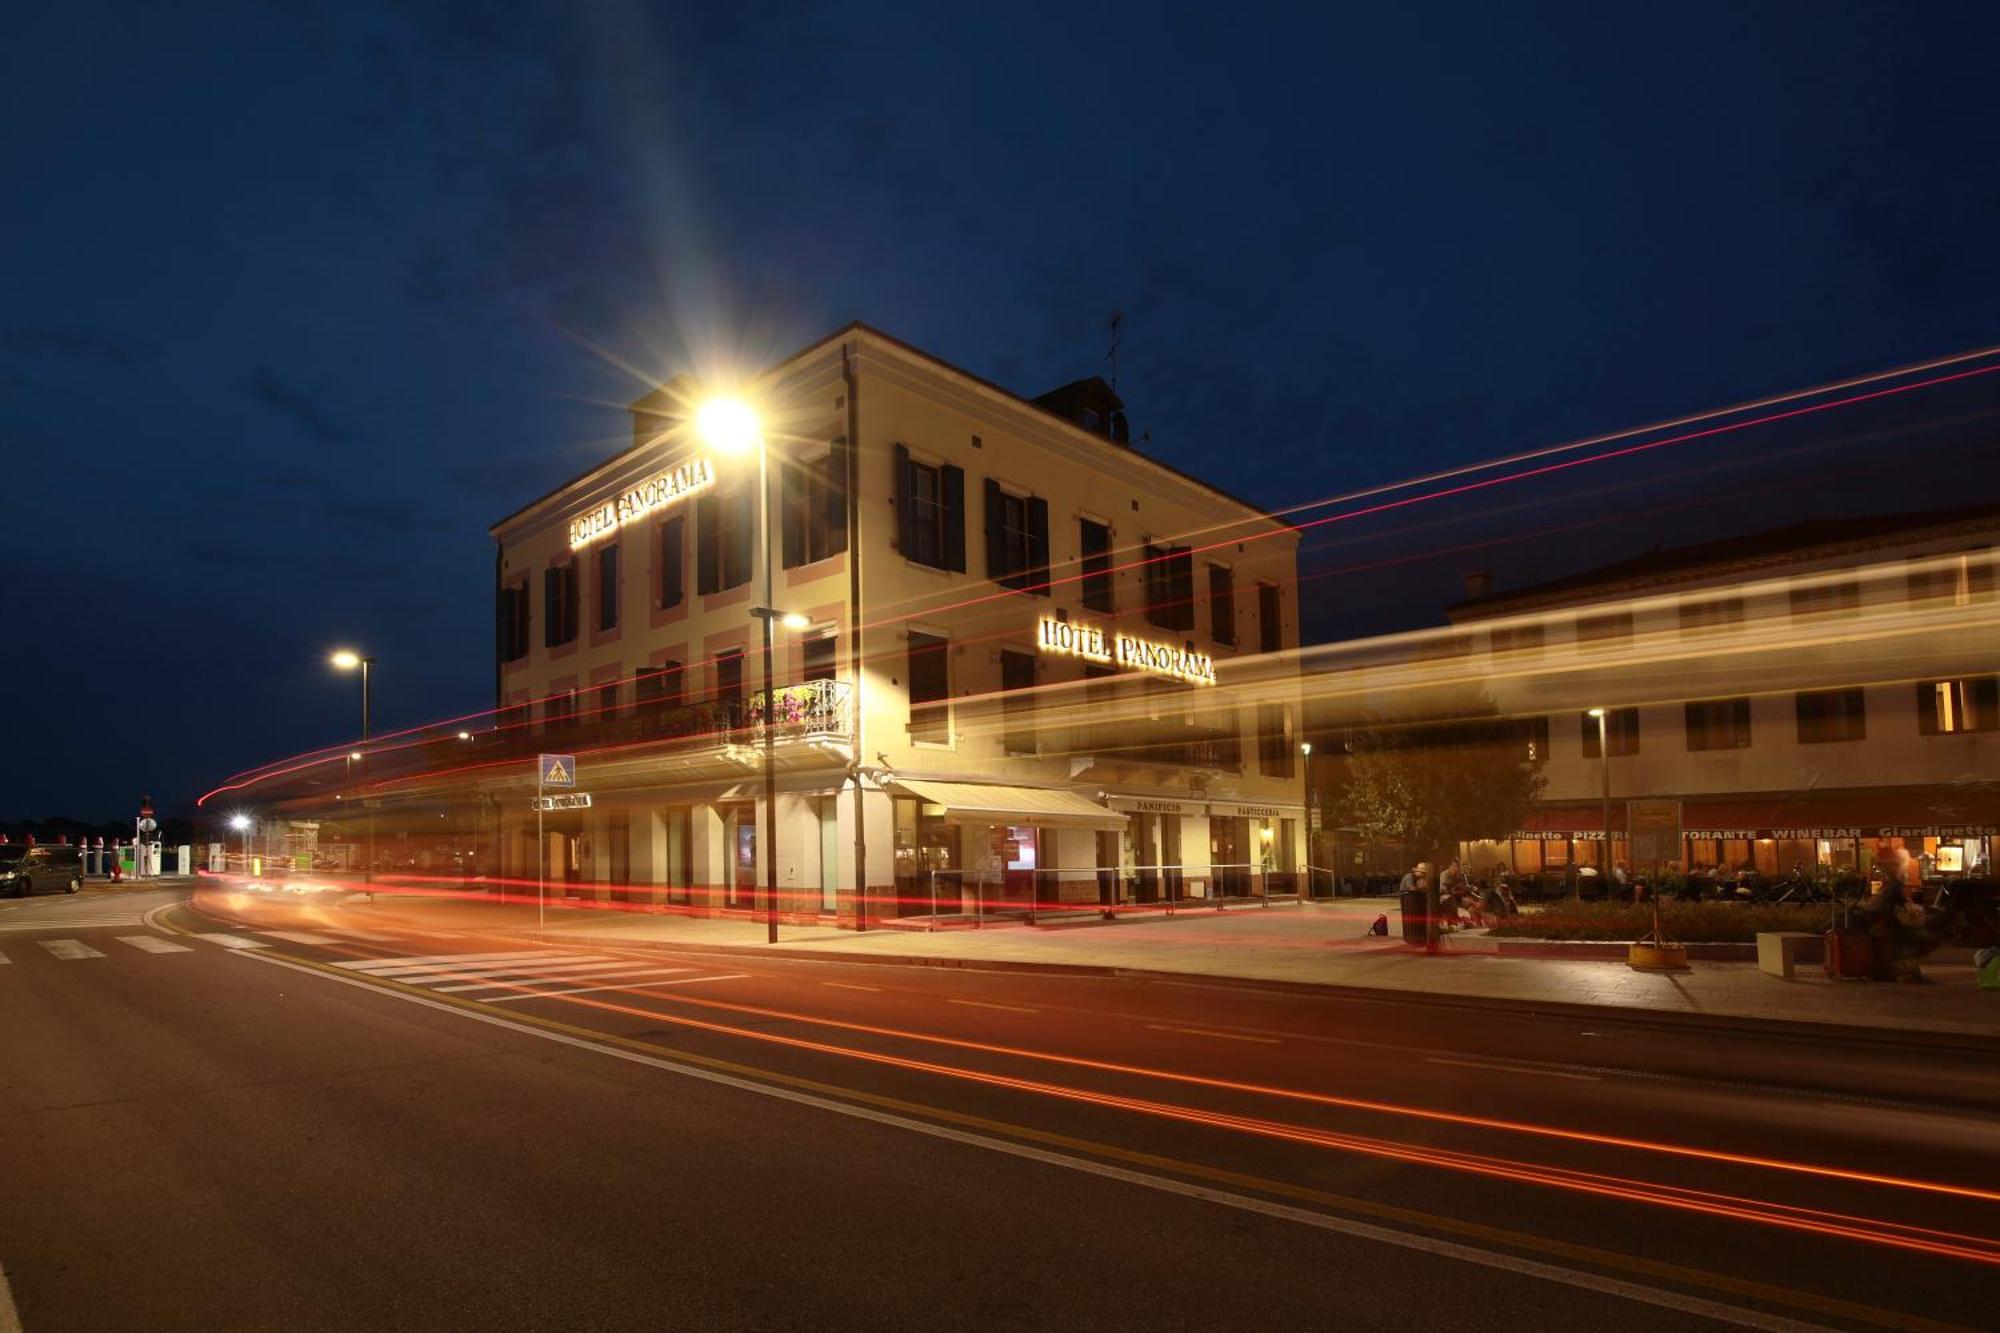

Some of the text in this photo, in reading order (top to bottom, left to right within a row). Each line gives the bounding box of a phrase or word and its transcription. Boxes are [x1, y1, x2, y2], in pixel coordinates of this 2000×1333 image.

[568, 458, 710, 545] HOTEL PANORAMA
[1043, 620, 1217, 681] HOTEL PANORAMA
[1771, 828, 1862, 839] WINEBAR
[1878, 825, 1997, 838] Giardinetto
